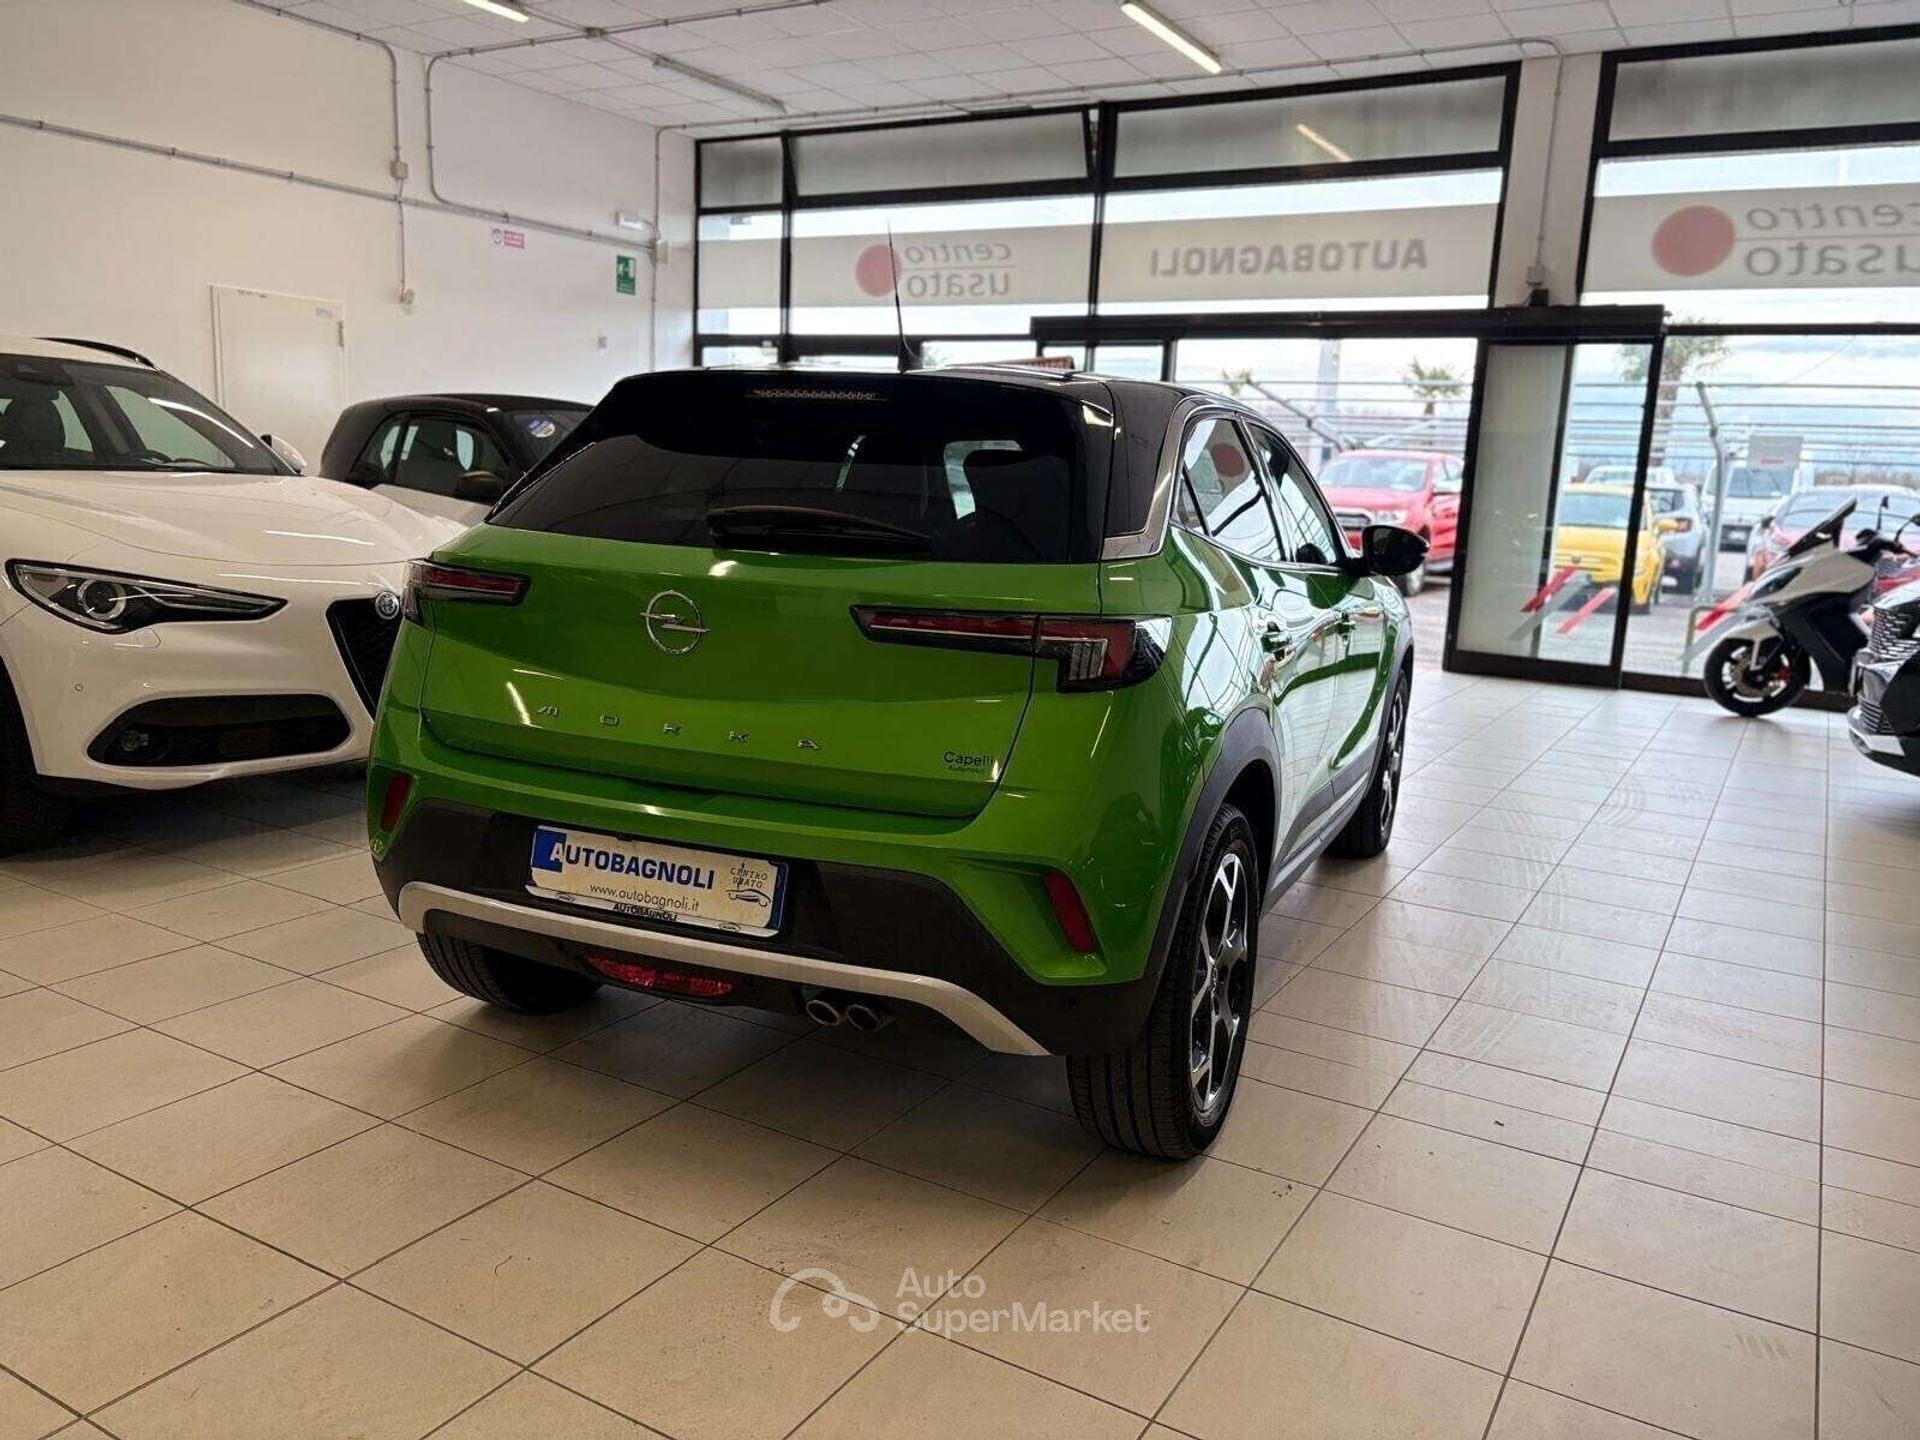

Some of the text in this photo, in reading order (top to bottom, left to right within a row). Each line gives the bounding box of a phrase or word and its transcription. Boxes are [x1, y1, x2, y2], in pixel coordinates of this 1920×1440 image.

[537, 703, 820, 750] MOKKA
[549, 842, 715, 890] AUTOBAGNOLI
[589, 884, 700, 912] www.autobagnoli.it
